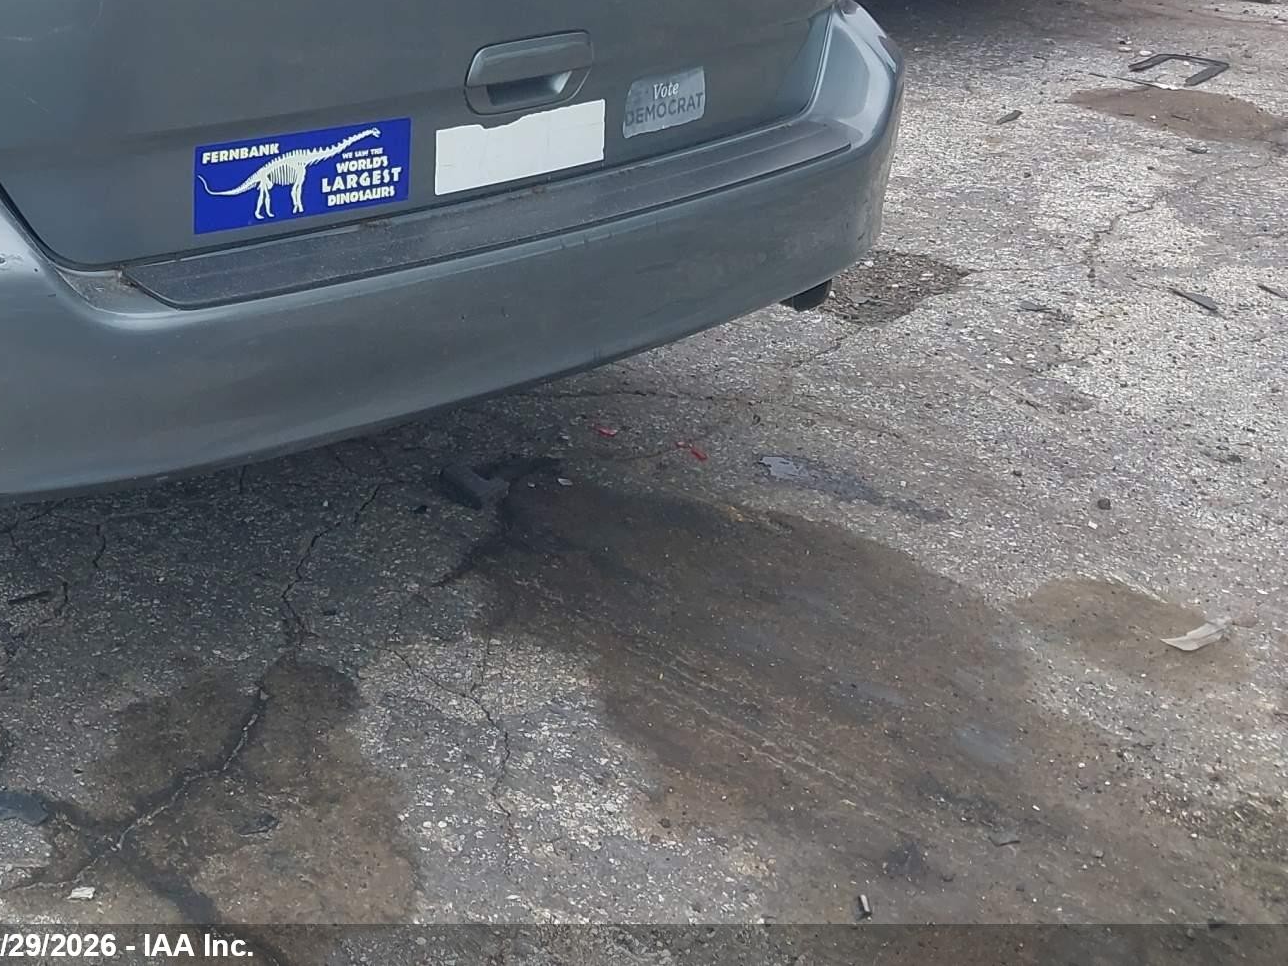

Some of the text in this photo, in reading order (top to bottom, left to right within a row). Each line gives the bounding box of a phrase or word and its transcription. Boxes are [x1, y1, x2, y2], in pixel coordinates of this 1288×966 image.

[653, 82, 680, 100] Vote
[625, 92, 704, 126] DEMOCRAT
[202, 143, 279, 164] FERNBANK
[370, 147, 384, 155] THE
[322, 167, 402, 192] LARGEST
[327, 185, 395, 206] DINOSAURS
